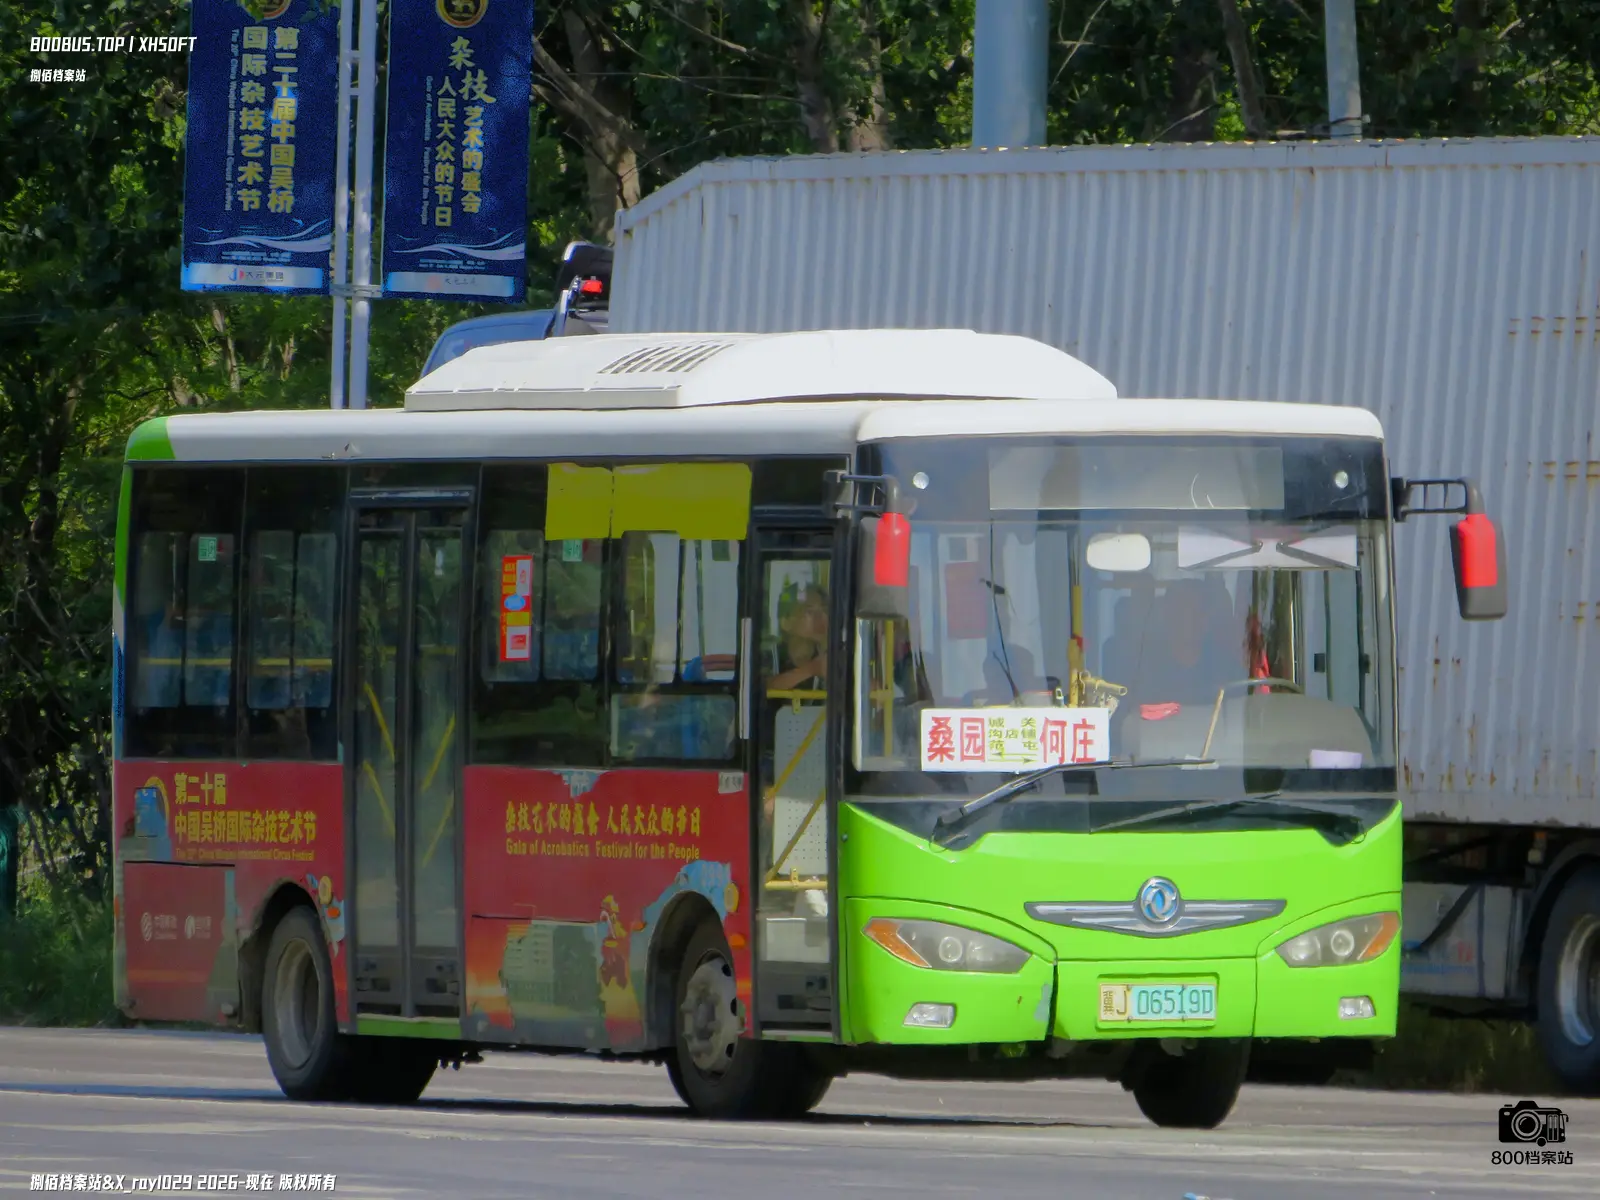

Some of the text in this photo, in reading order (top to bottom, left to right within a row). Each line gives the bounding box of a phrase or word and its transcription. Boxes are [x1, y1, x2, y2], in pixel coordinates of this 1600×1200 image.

[236, 26, 268, 212] 国际杂技艺术节
[267, 26, 300, 213] 第二十届中国吴桥
[434, 75, 458, 227] 人民大众的节日
[927, 716, 986, 763] 桑园
[1039, 717, 1097, 764] 何庄
[174, 772, 226, 805] 第二十届
[174, 809, 317, 845] 中国吴桥国际杂技艺术节
[505, 838, 700, 863] Gala of Acrobatics Festival for the People
